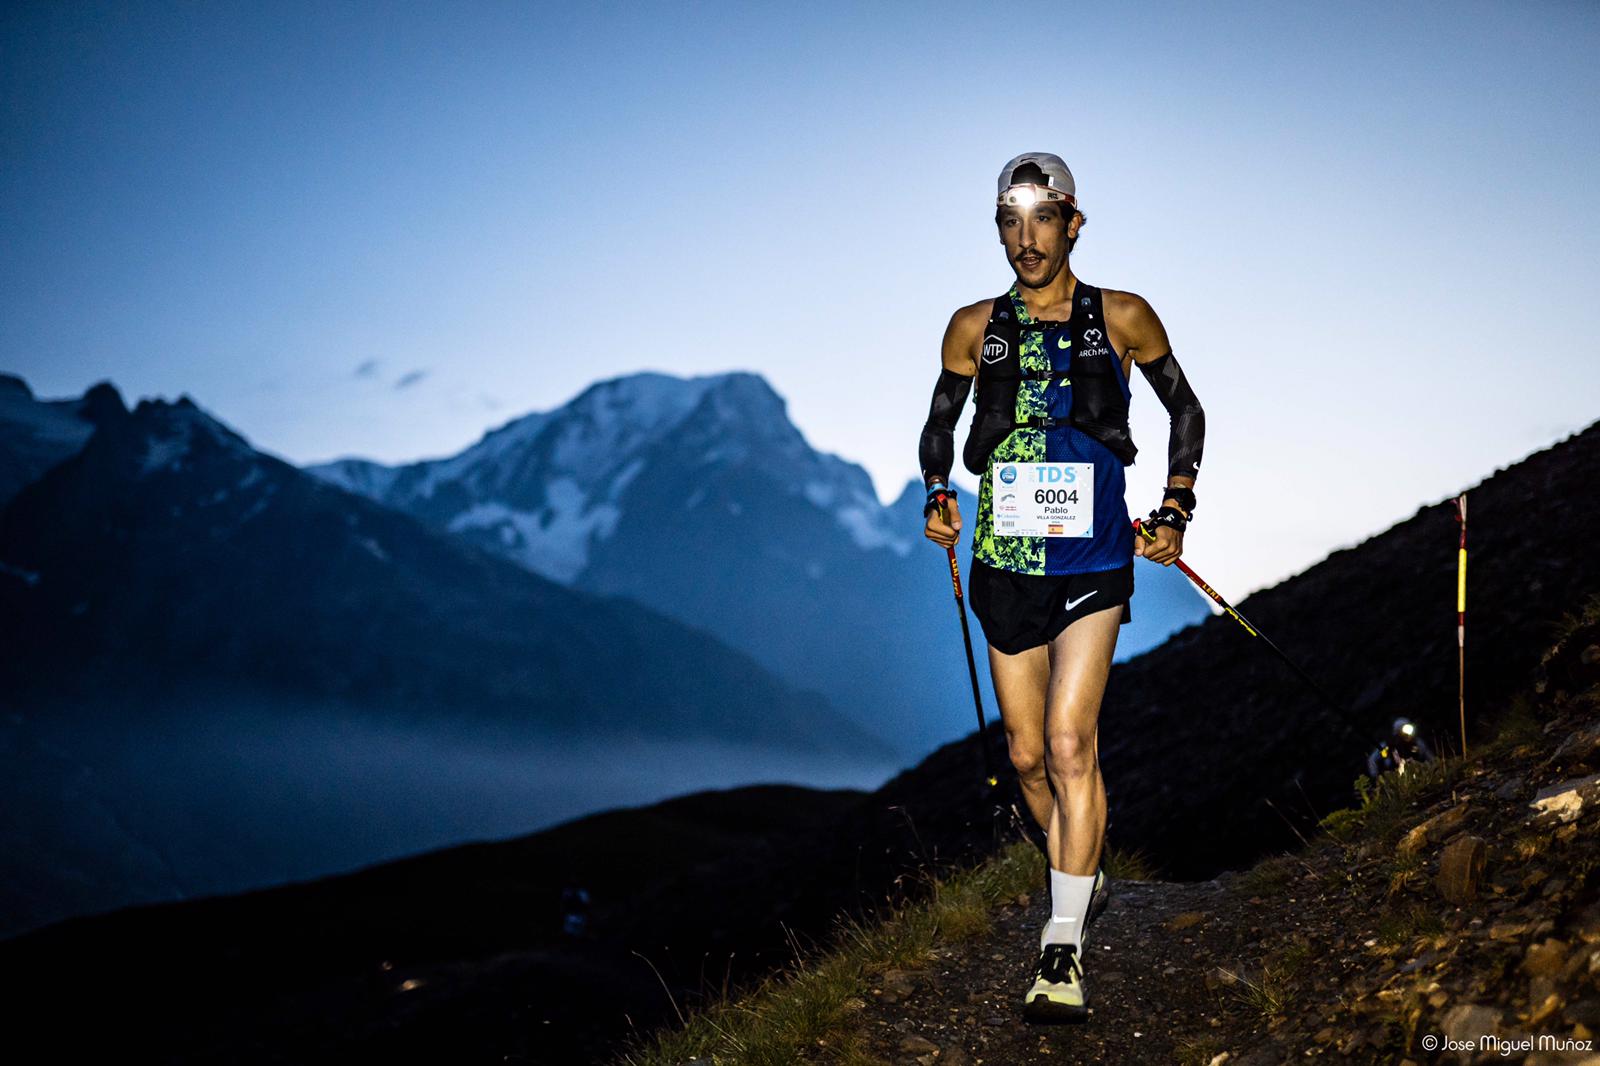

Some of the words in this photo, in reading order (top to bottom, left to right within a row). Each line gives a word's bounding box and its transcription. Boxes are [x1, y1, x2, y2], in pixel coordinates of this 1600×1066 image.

[983, 343, 1004, 356] WTP
[1035, 466, 1076, 483] TDS
[1034, 489, 1079, 505] 6004
[1044, 506, 1068, 514] Pablo
